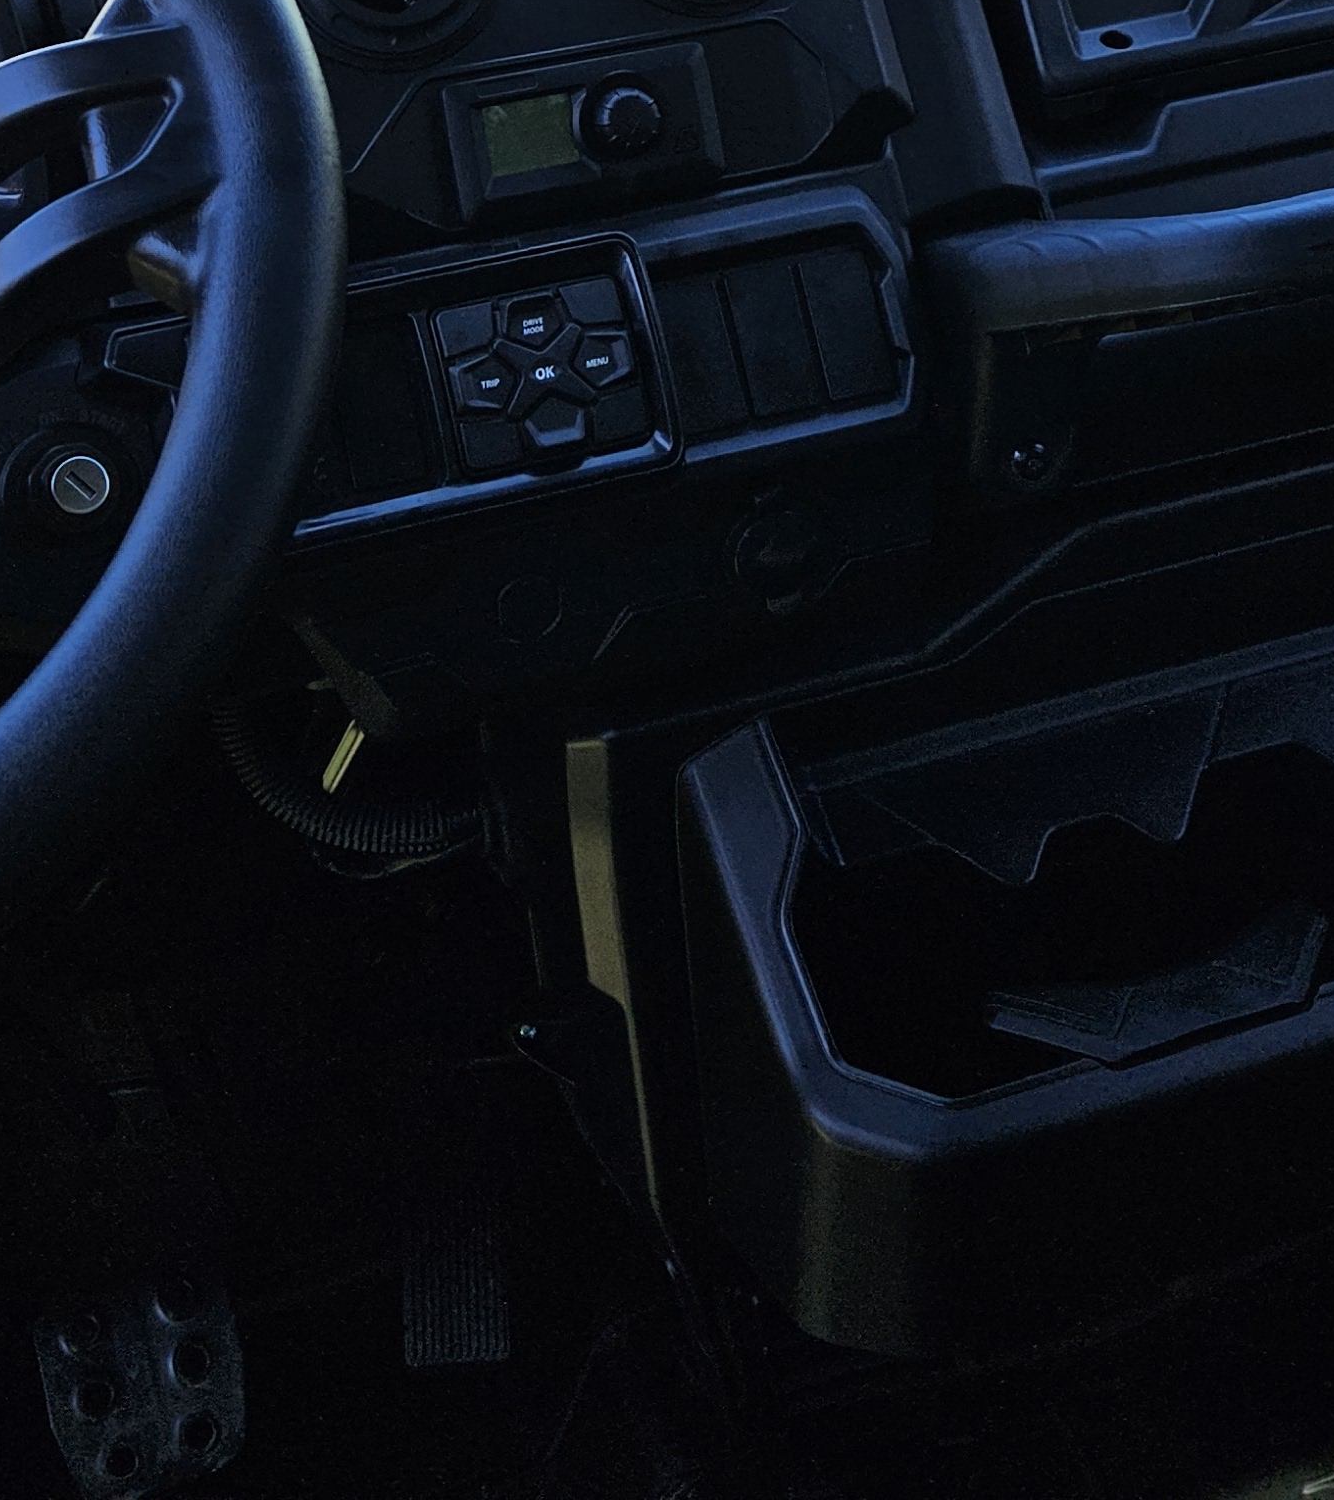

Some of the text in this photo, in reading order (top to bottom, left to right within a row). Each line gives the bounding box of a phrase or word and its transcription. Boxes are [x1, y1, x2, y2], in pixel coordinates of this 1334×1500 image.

[522, 317, 544, 328] DRIVE
[523, 326, 544, 336] MODE
[586, 356, 609, 368] MENU
[535, 366, 555, 380] OK
[481, 378, 500, 389] TRIP
